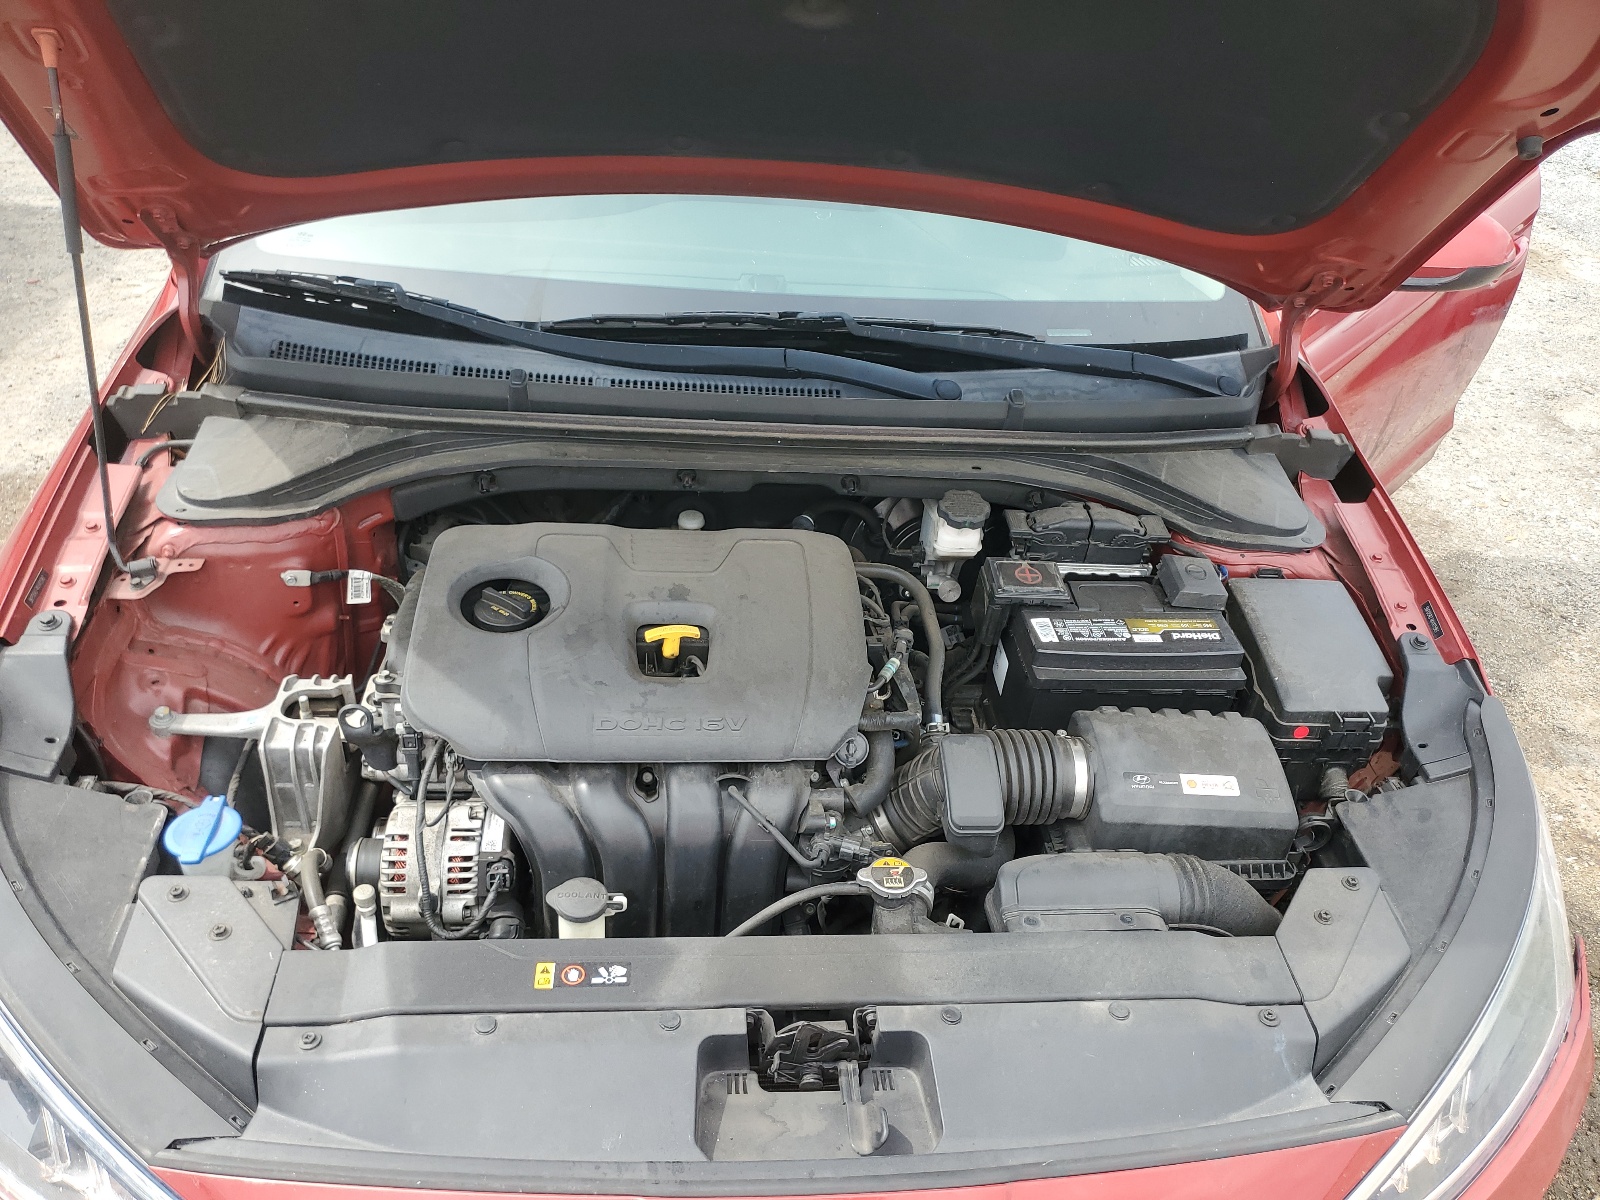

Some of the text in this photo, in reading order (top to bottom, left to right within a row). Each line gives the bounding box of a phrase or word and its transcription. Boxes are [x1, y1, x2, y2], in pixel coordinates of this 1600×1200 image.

[1171, 629, 1221, 641] DieHard
[595, 716, 747, 732] DOHC 16V
[557, 891, 607, 899] COOLANT
